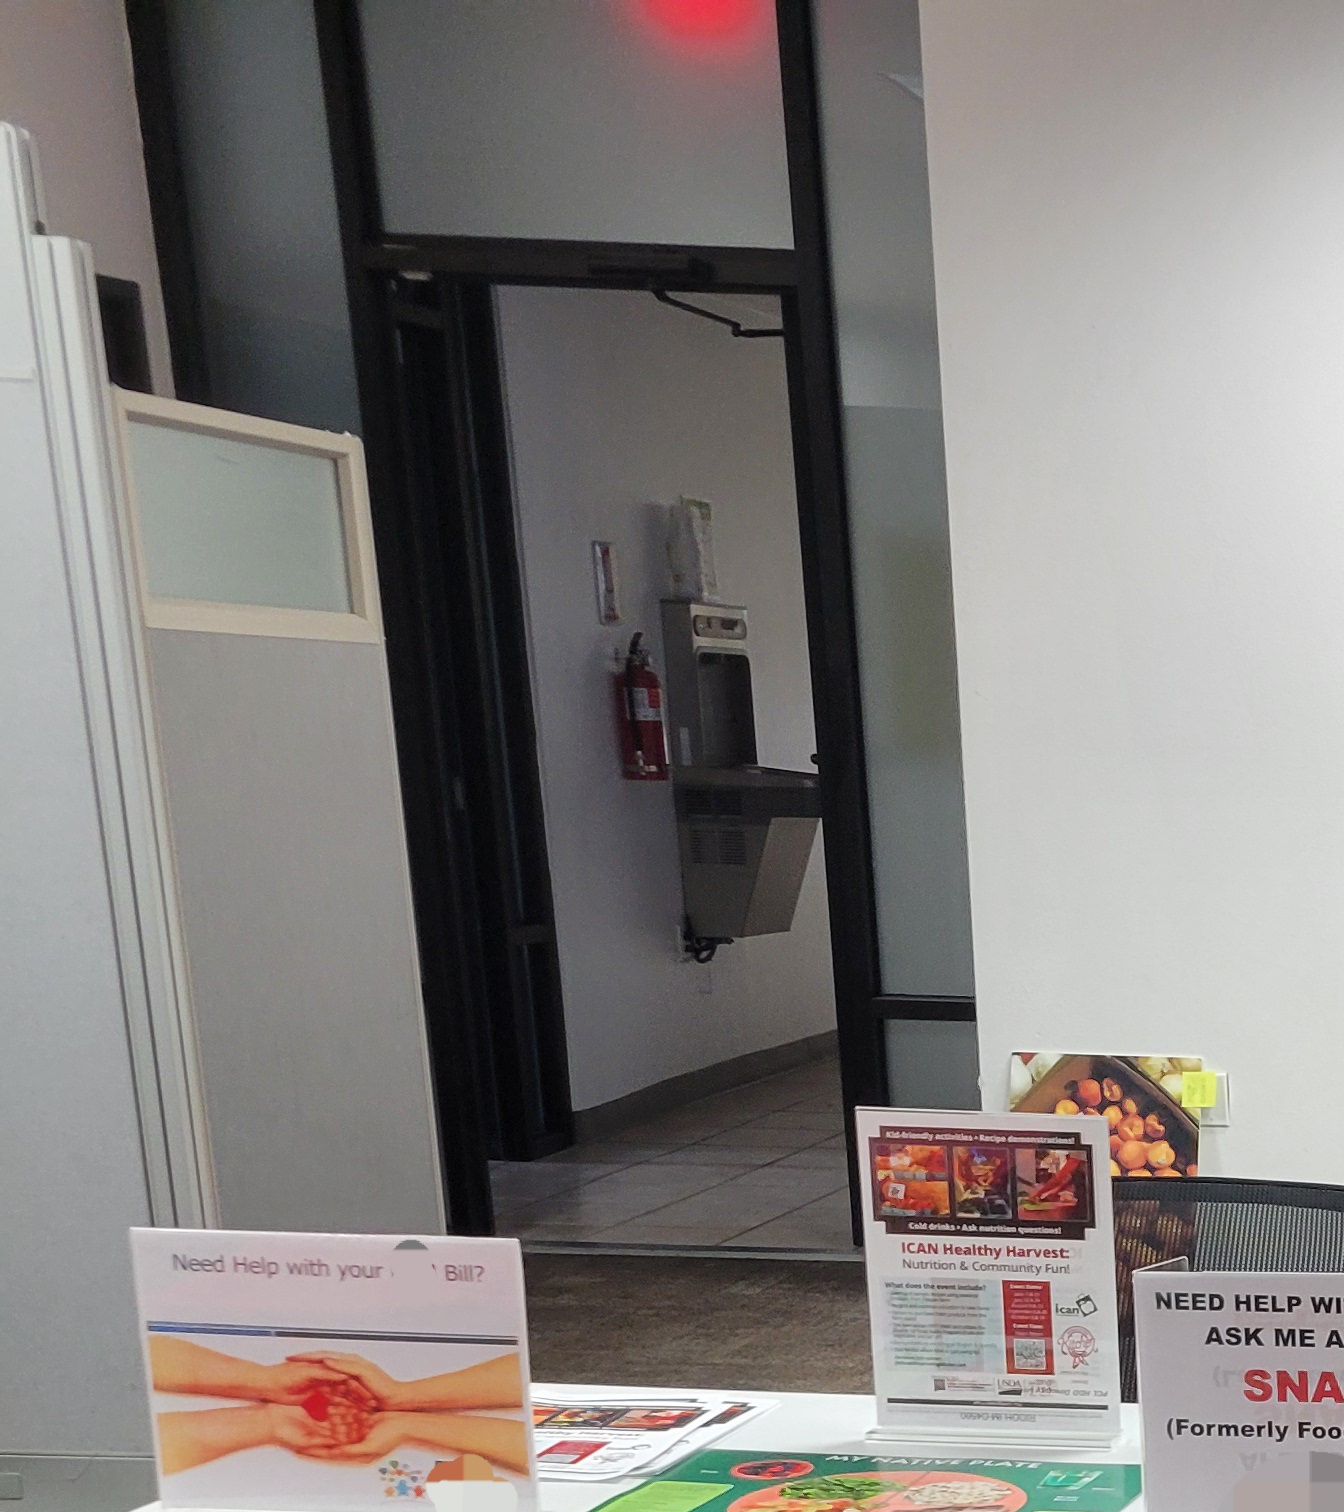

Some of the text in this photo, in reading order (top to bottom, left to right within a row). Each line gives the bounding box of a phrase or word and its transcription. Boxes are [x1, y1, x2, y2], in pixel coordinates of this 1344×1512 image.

[909, 1222, 927, 1230] Cold
[929, 1223, 955, 1231] drinks
[962, 1224, 977, 1232] Ask
[902, 1242, 938, 1254] ICAN
[943, 1243, 1001, 1259] Healthy
[173, 1254, 225, 1273] Need
[233, 1255, 279, 1278] Help
[288, 1258, 330, 1278] with
[338, 1264, 381, 1282] your
[445, 1265, 484, 1283] Bill?
[902, 1259, 1070, 1275] Nutrition & Community Fun!
[1155, 1291, 1225, 1311] NEED
[1234, 1293, 1301, 1313] HELP
[1205, 1327, 1264, 1347] ASK
[1274, 1329, 1315, 1348] ME
[1166, 1417, 1288, 1443] (Formerly
[871, 1456, 964, 1466] NATIVE
[969, 1459, 1042, 1469] PLATE
